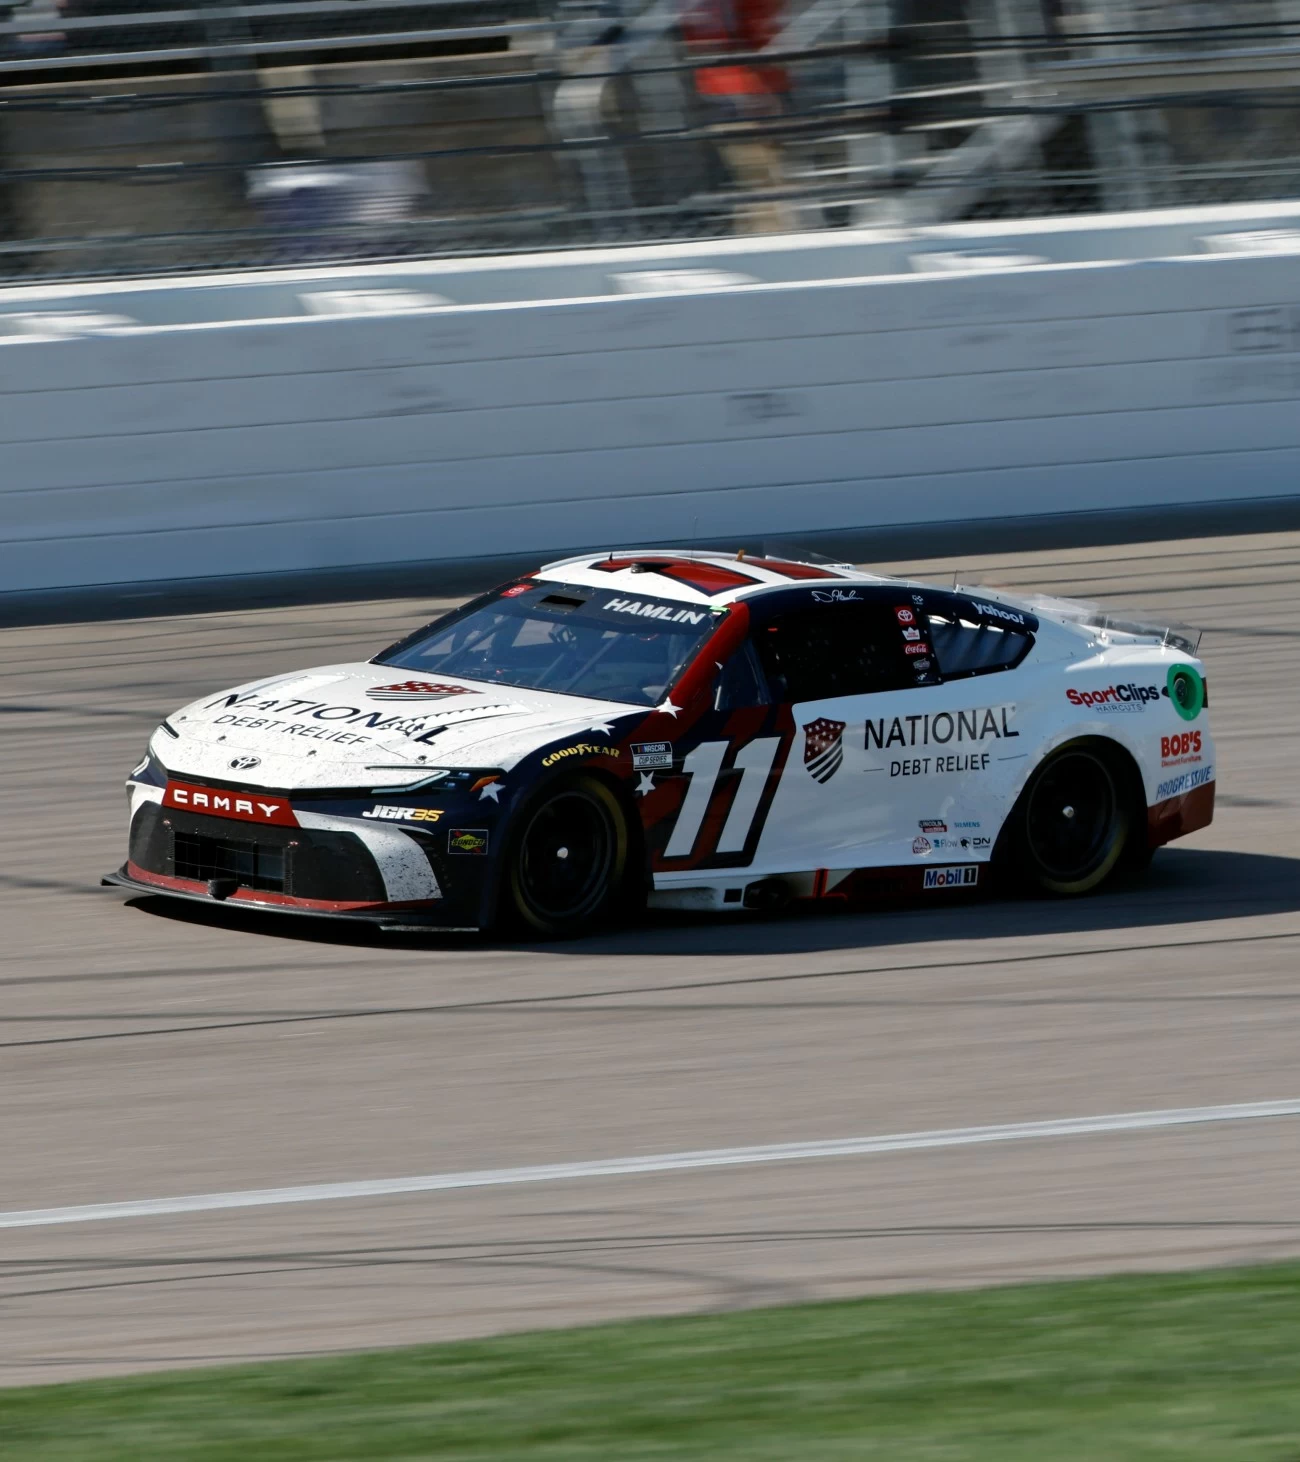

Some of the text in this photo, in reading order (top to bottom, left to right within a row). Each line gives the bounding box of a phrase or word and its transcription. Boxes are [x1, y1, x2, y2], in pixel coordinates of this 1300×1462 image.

[603, 599, 705, 625] HAMLIN
[972, 602, 1024, 625] yahoo!
[1066, 683, 1160, 708] SportClips
[1096, 704, 1143, 713] HAIRCUTS
[213, 714, 372, 746] DEBT RELIEF
[864, 706, 1020, 750] NATIONAL
[541, 743, 621, 767] GOODYEAR
[644, 744, 666, 752] NASCAR
[1161, 730, 1202, 758] BOB'S
[639, 755, 667, 765] CUP SERIES
[890, 753, 990, 777] DEBT RELIEF
[1155, 765, 1213, 800] PROGRESSIVE
[173, 789, 280, 818] CAMRY
[663, 737, 781, 857] 11
[362, 804, 445, 822] JGR35
[452, 838, 484, 847] SUNOCO
[941, 839, 958, 848] Flow
[973, 837, 990, 845] DN
[925, 869, 961, 887] Mobil
